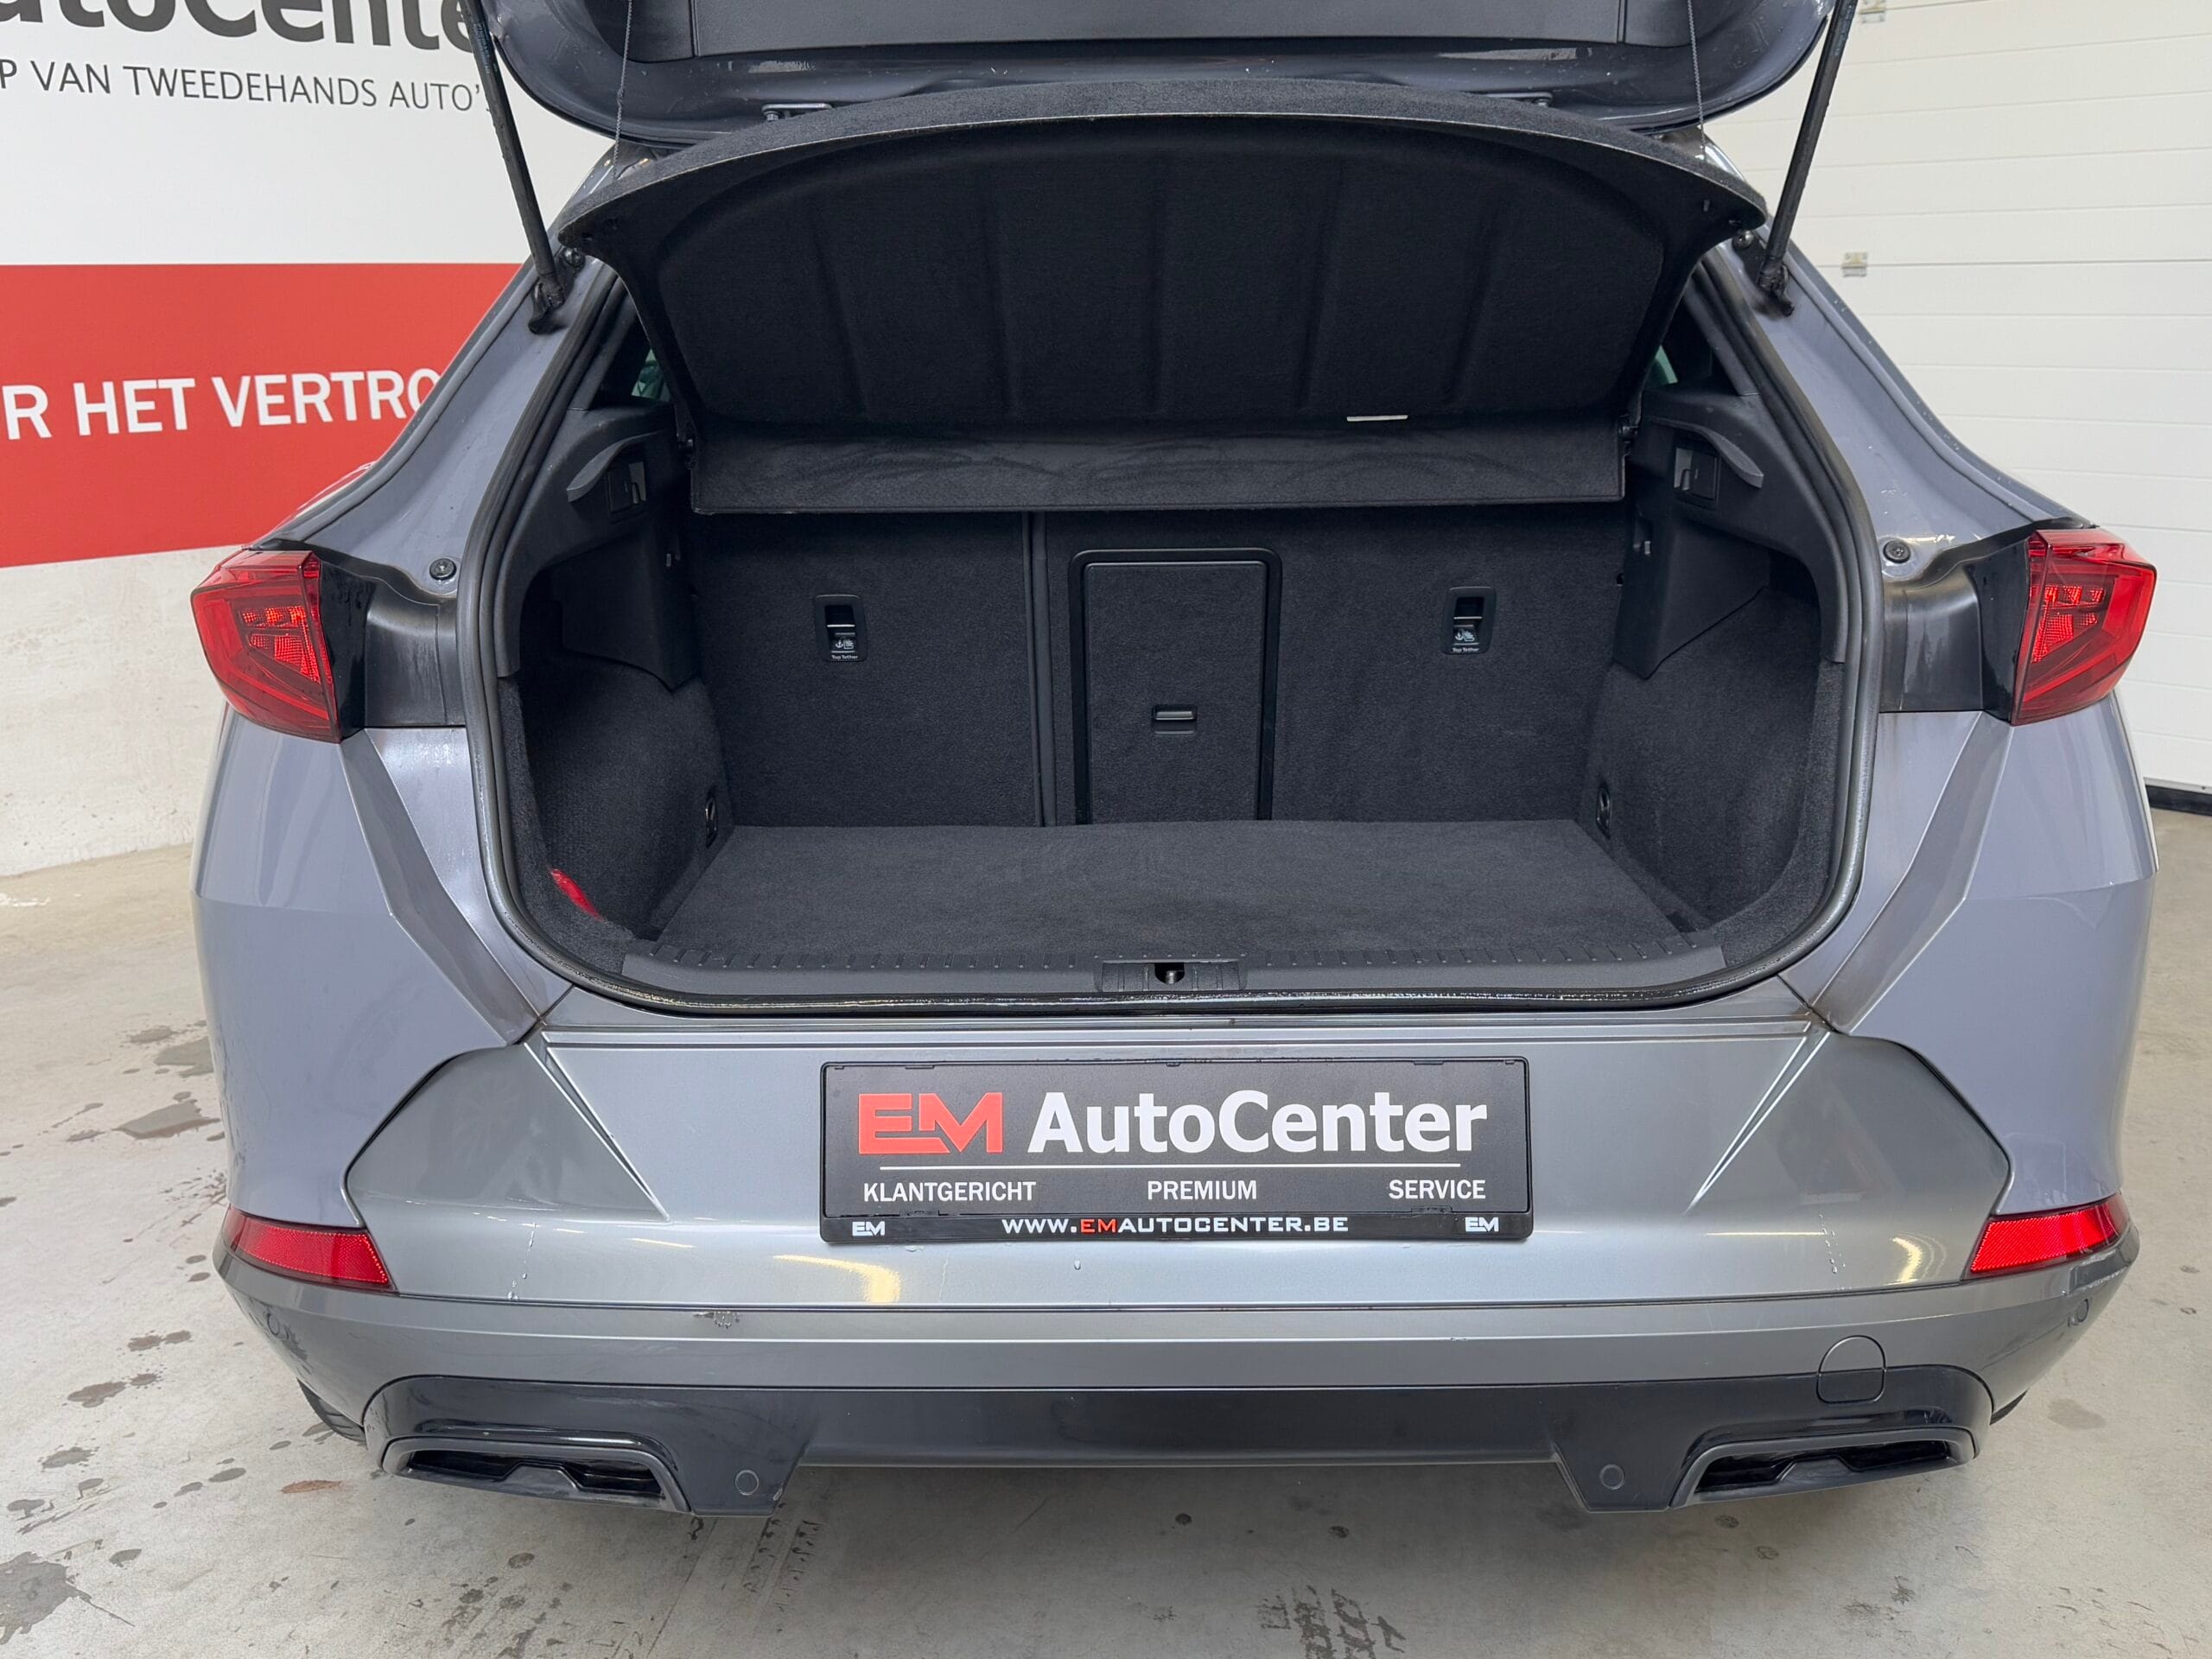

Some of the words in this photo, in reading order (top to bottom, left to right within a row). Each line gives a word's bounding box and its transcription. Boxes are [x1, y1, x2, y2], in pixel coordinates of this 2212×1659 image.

[0, 59, 17, 89] P
[30, 60, 111, 94] VAN
[123, 66, 377, 107] TWEEDEHANDS
[389, 80, 490, 112] AUTO'
[2, 385, 52, 441] R
[73, 378, 196, 436] HET
[212, 368, 442, 428] VERTRO
[858, 1092, 1003, 1155] EM
[1027, 1089, 1488, 1154] AutoCenter
[864, 1181, 1037, 1203] KLANTGERICHT
[1147, 1179, 1258, 1200] PREMIUM
[1389, 1179, 1487, 1199] SERVICE
[852, 1220, 886, 1236] EM
[1001, 1216, 1350, 1235] WWW.EMAUTOCENTER.BE
[1465, 1217, 1500, 1233] EM
